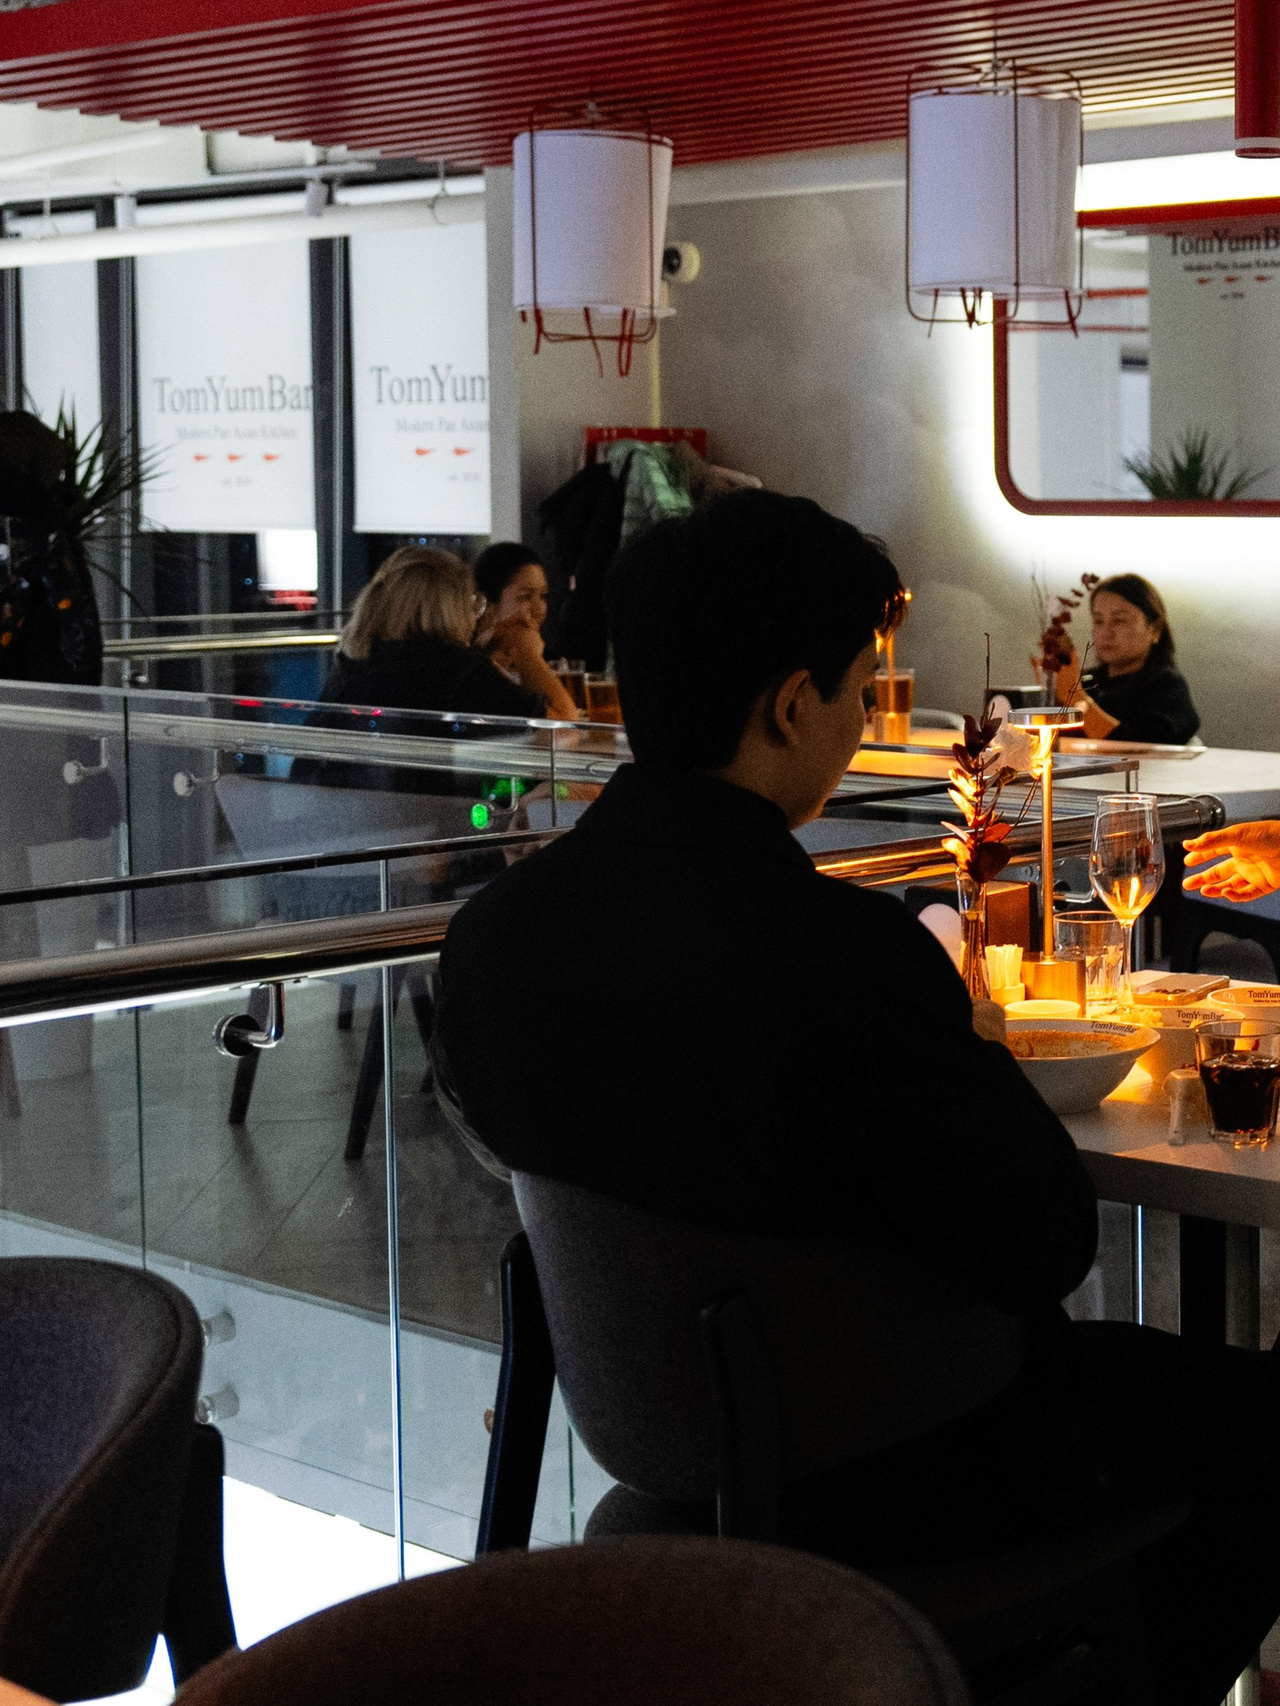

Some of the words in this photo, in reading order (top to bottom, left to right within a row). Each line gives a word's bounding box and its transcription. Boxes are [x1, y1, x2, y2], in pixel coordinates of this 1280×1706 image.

[151, 373, 313, 413] TomYumBar
[1176, 1010, 1224, 1020] TomYmBar
[1090, 1021, 1138, 1034] TomYumBar
